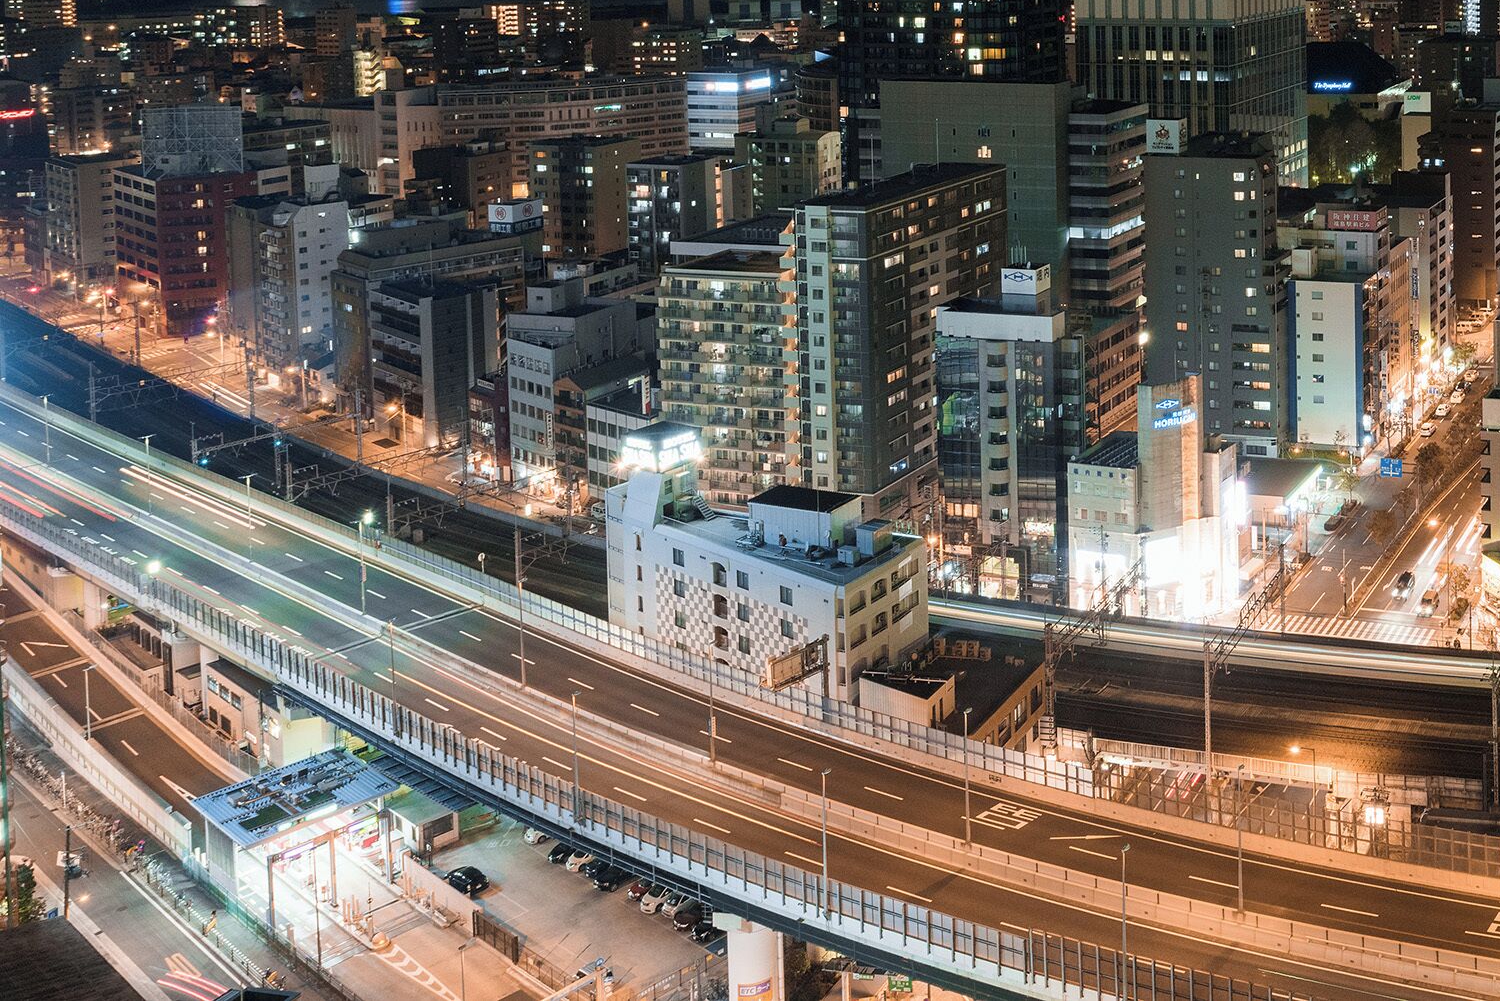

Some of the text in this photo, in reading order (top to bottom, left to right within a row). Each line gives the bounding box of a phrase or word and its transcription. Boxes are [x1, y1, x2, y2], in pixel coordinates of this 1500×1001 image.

[1333, 213, 1370, 222] 阪神住建
[1154, 412, 1196, 428] HORIUCHI
